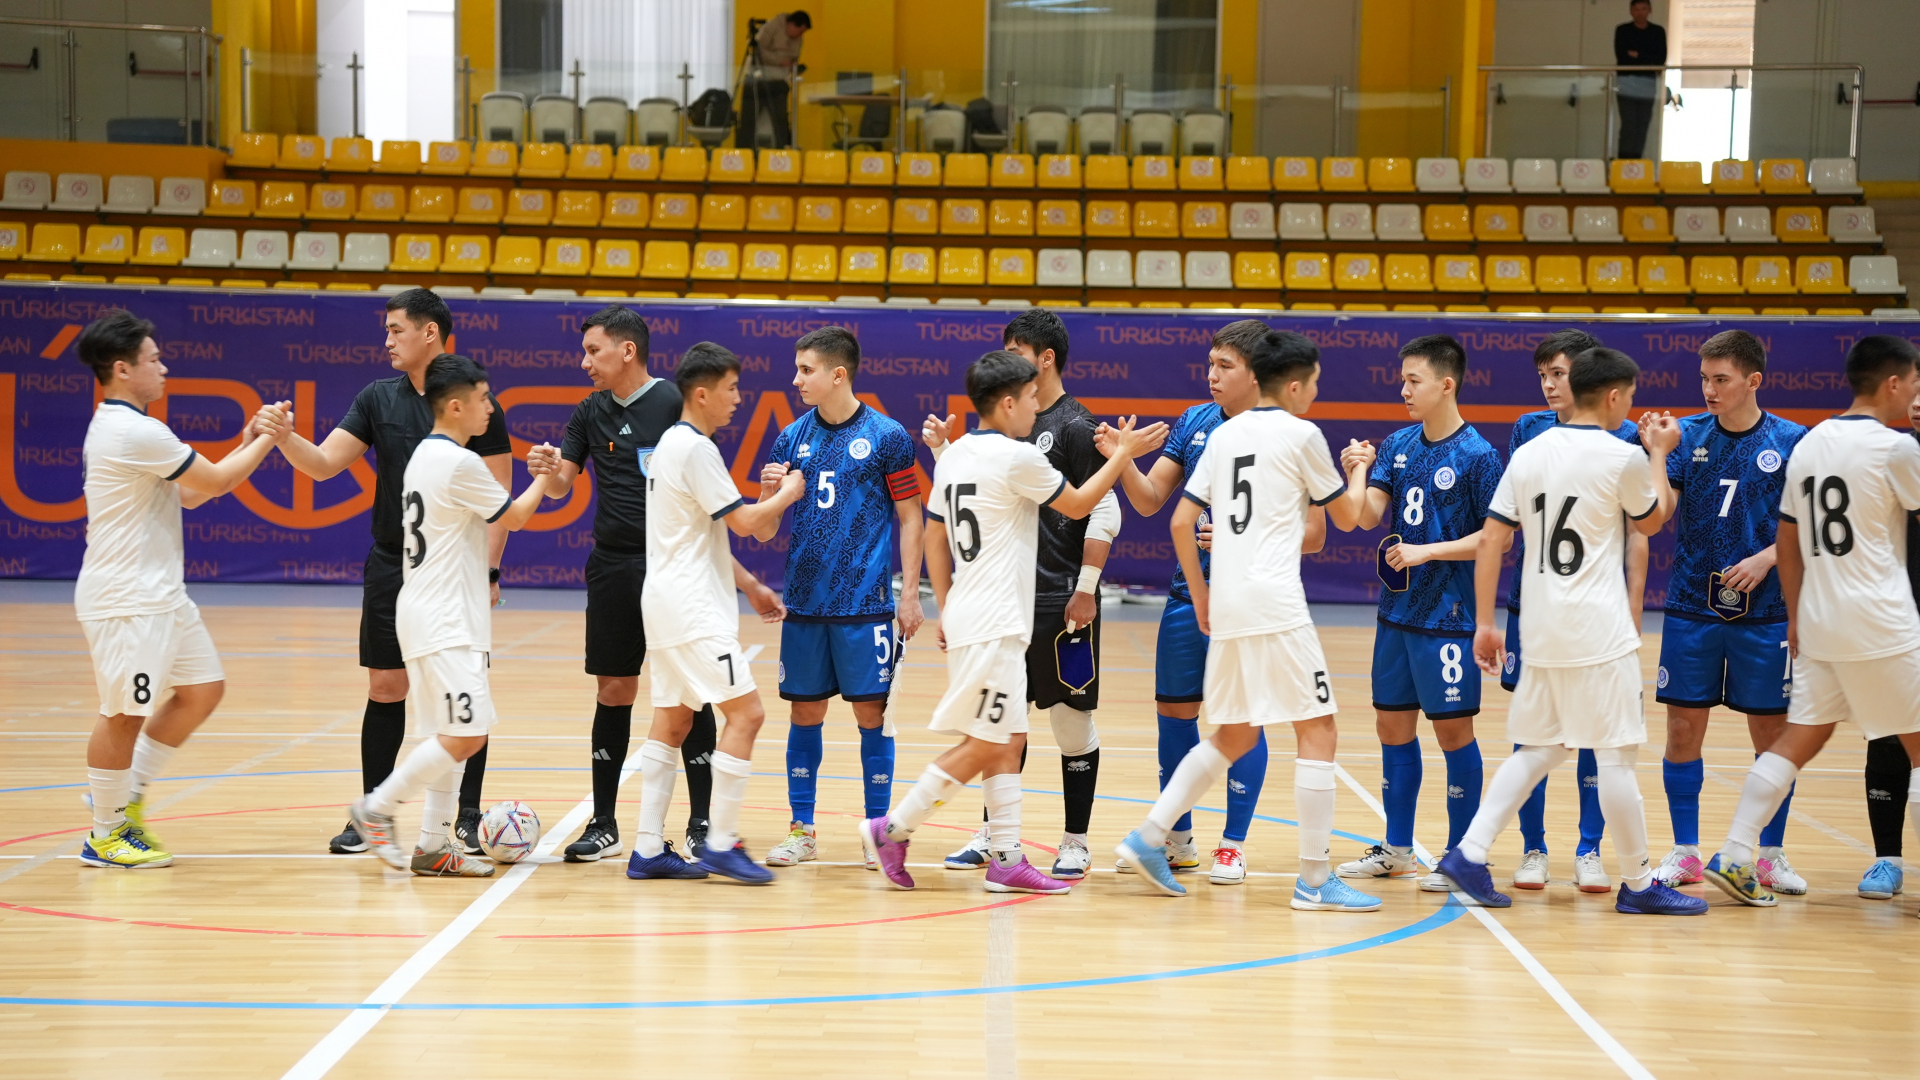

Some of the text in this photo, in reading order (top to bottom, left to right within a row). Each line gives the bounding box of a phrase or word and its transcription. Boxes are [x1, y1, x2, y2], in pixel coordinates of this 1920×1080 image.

[817, 471, 836, 509] 5
[1230, 453, 1257, 535] 5
[1403, 486, 1425, 526] 8
[1718, 478, 1739, 518] 7
[943, 483, 982, 563] 15
[1532, 492, 1584, 576] 16
[1800, 475, 1854, 557] 18
[873, 624, 891, 665] 5
[1439, 643, 1463, 684] 8
[133, 672, 151, 704] 8
[717, 653, 735, 687] 7
[1313, 671, 1330, 704] 5
[443, 692, 473, 724] 13
[975, 688, 1009, 724] 15
